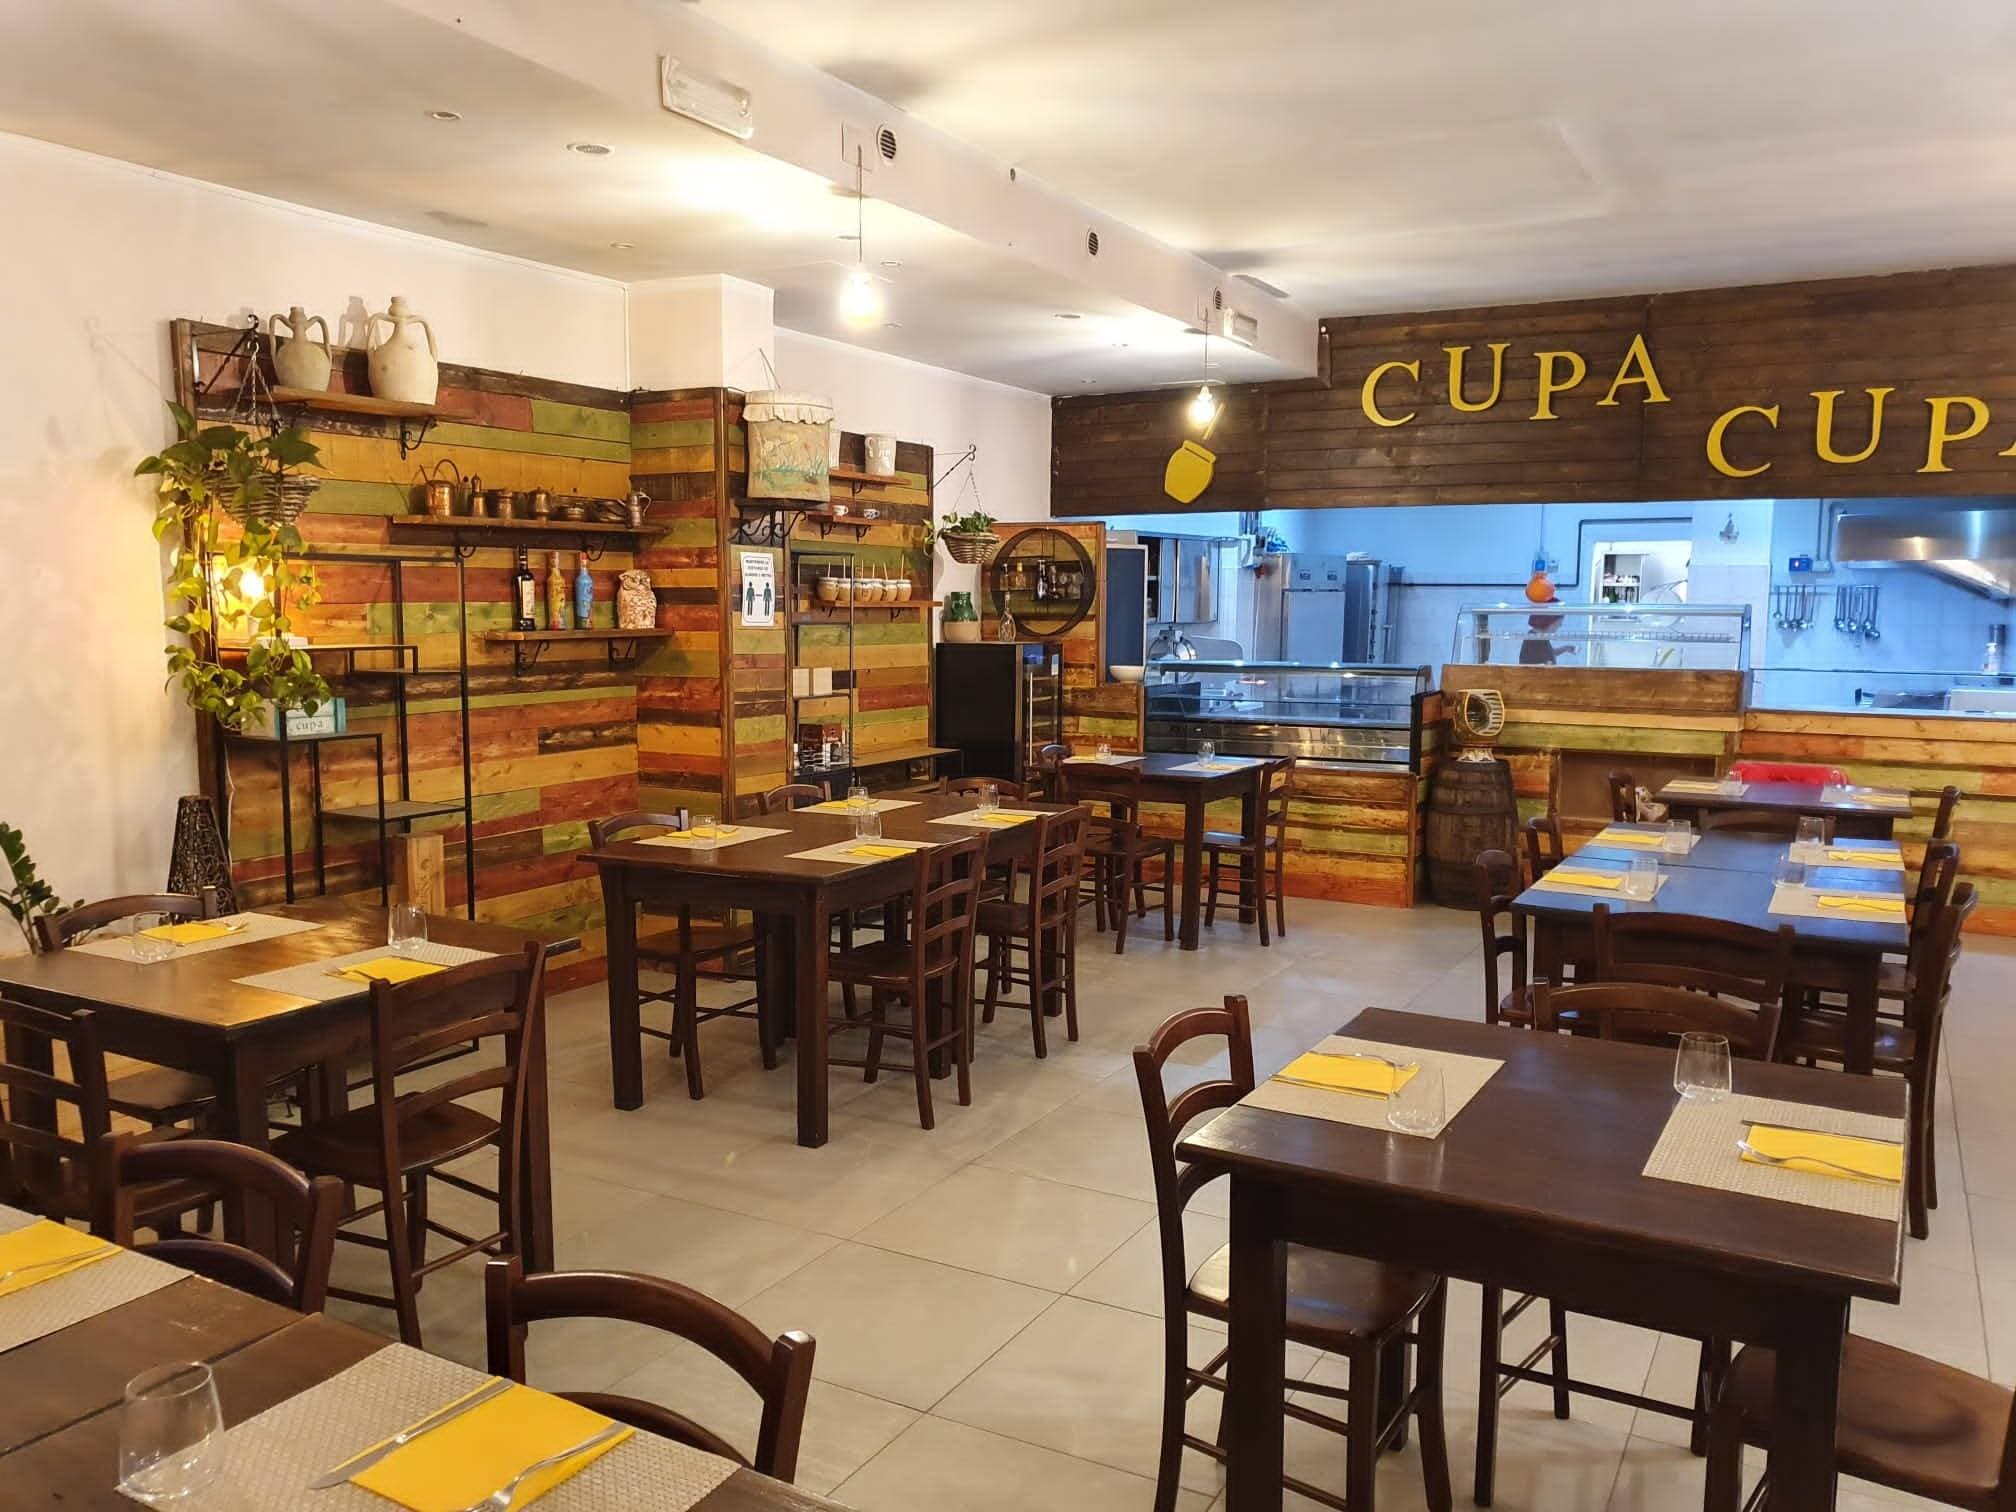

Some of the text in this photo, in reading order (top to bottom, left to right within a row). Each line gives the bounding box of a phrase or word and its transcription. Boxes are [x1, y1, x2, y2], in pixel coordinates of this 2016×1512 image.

[1360, 333, 1671, 427] CUPA
[1706, 386, 2016, 477] CUP
[296, 720, 323, 731] cupa
